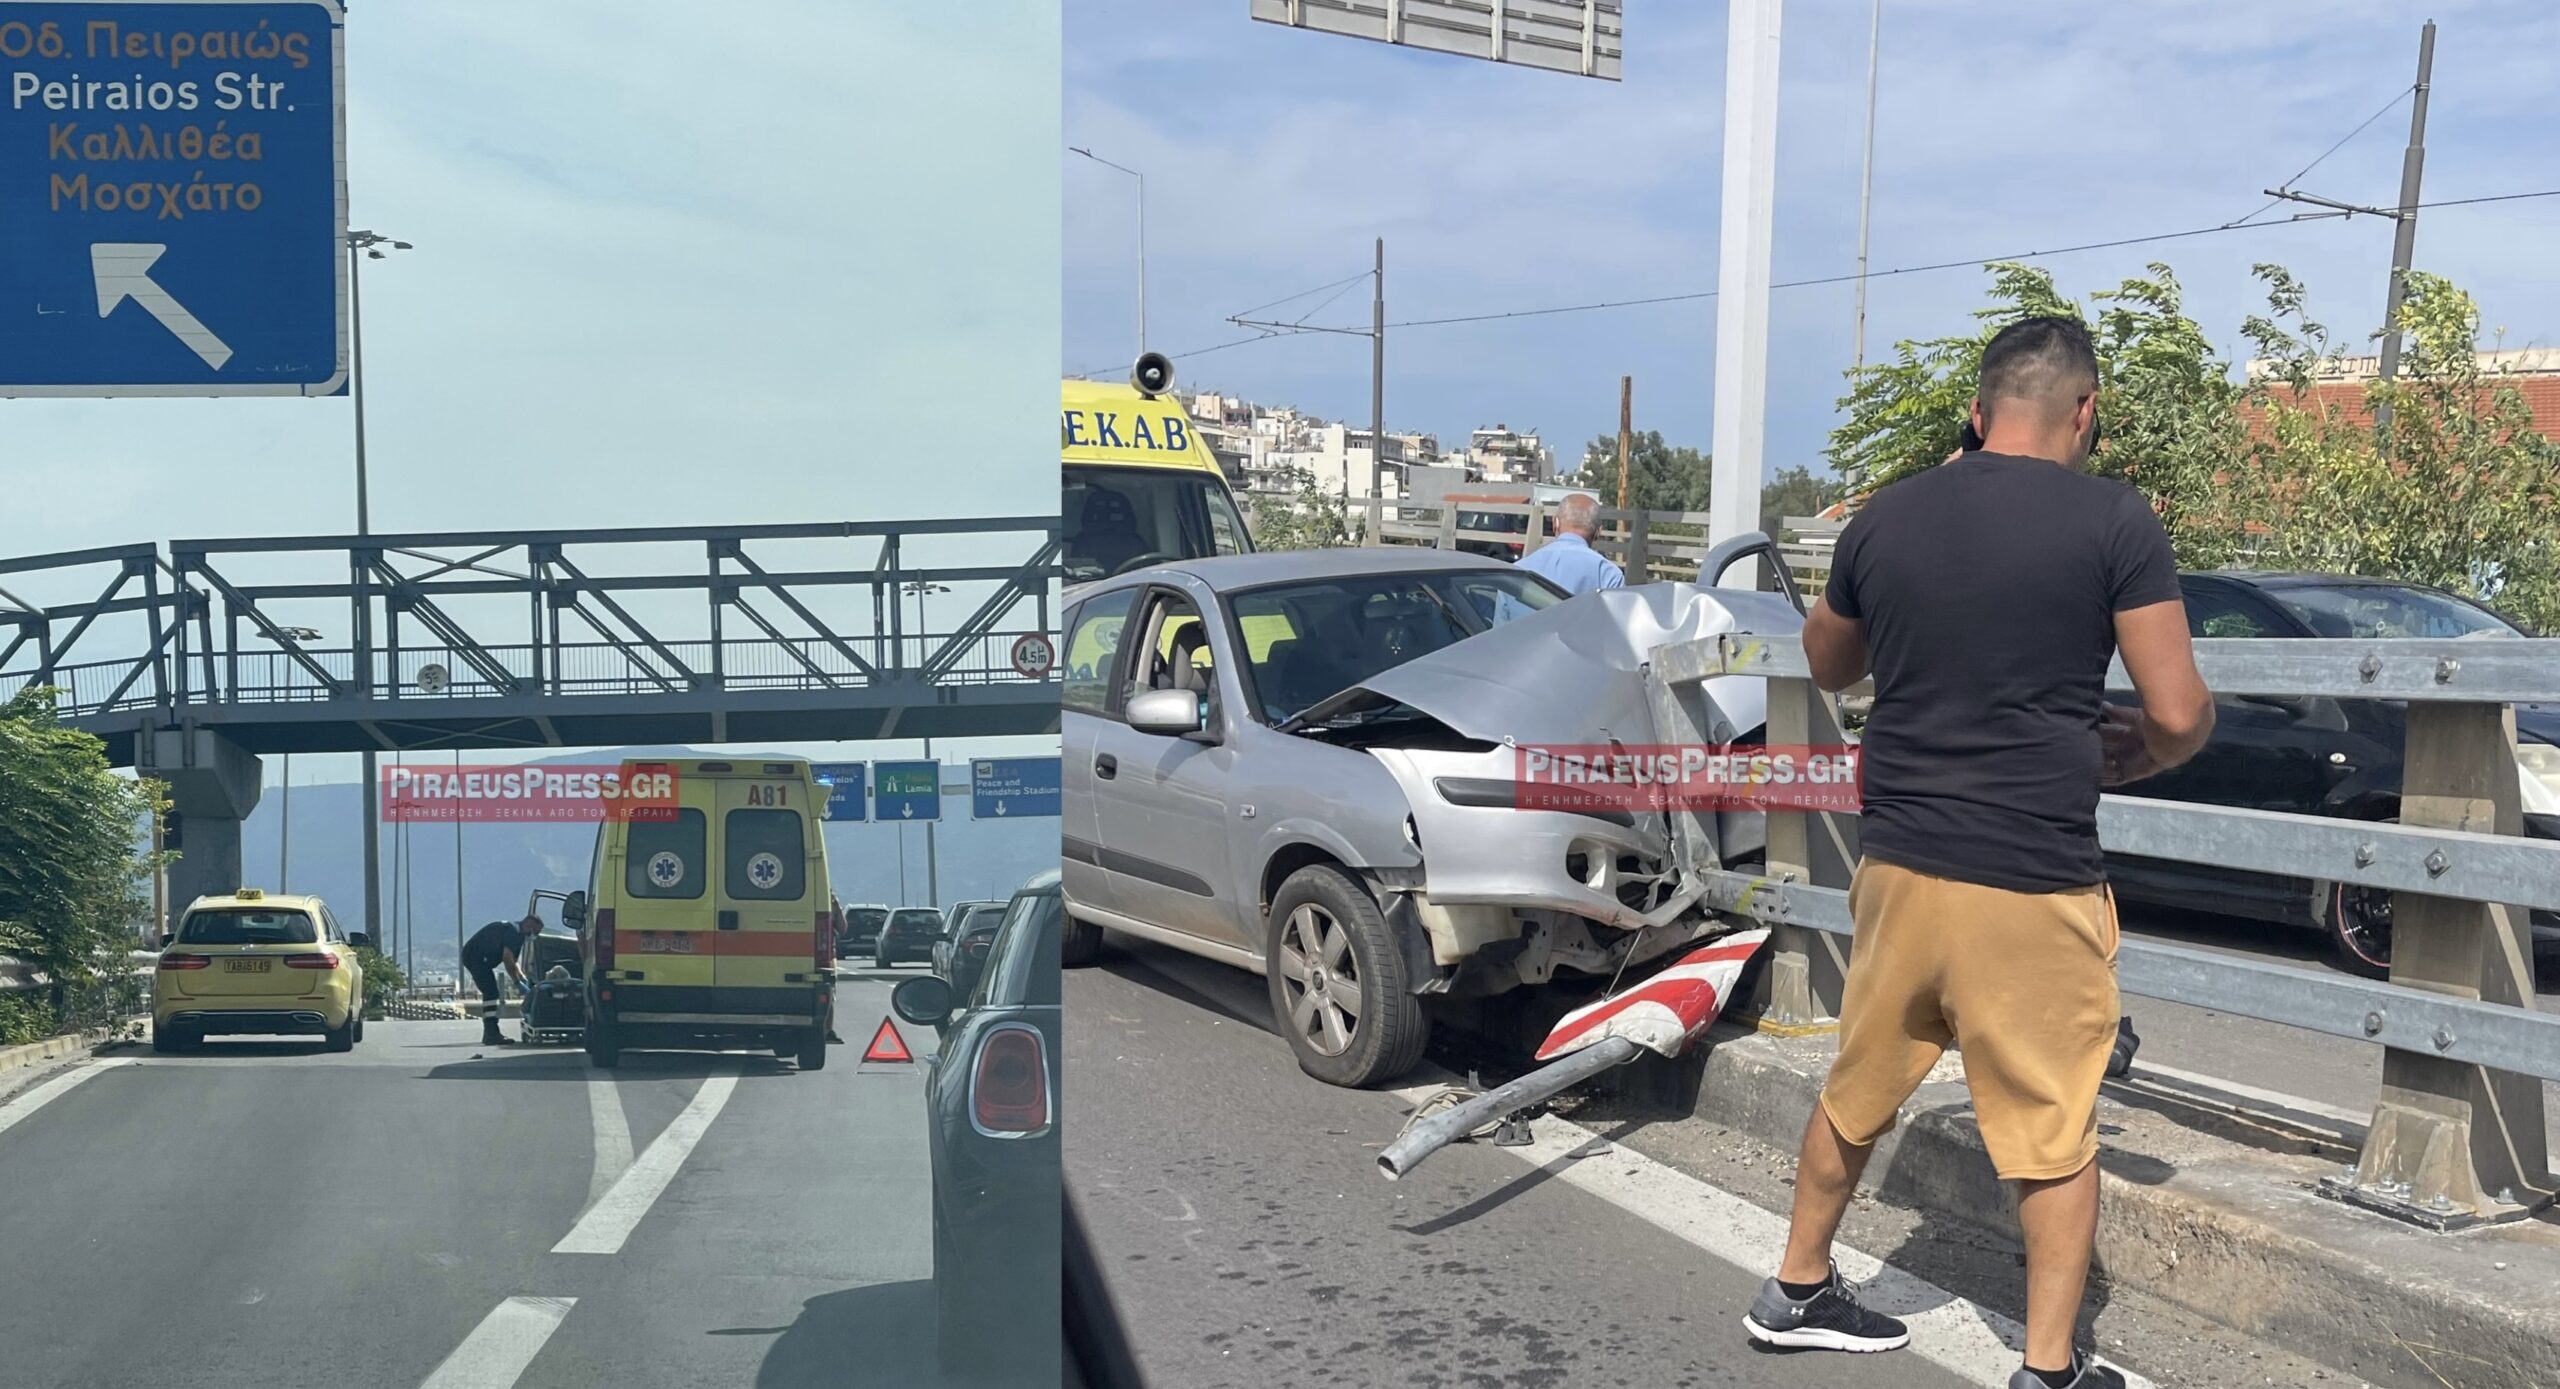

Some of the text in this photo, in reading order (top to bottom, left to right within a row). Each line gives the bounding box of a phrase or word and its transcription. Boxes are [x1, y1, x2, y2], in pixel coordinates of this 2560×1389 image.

[87, 19, 310, 69] Πειραιώς
[13, 72, 295, 112] Peiraios Str.
[49, 121, 262, 161] Καλλιθέα
[50, 171, 263, 220] Μοσχάτο
[748, 785, 787, 806] A81
[905, 784, 932, 793] Lamia
[976, 786, 1059, 797] Friendship Stadium
[1004, 778, 1020, 787] and
